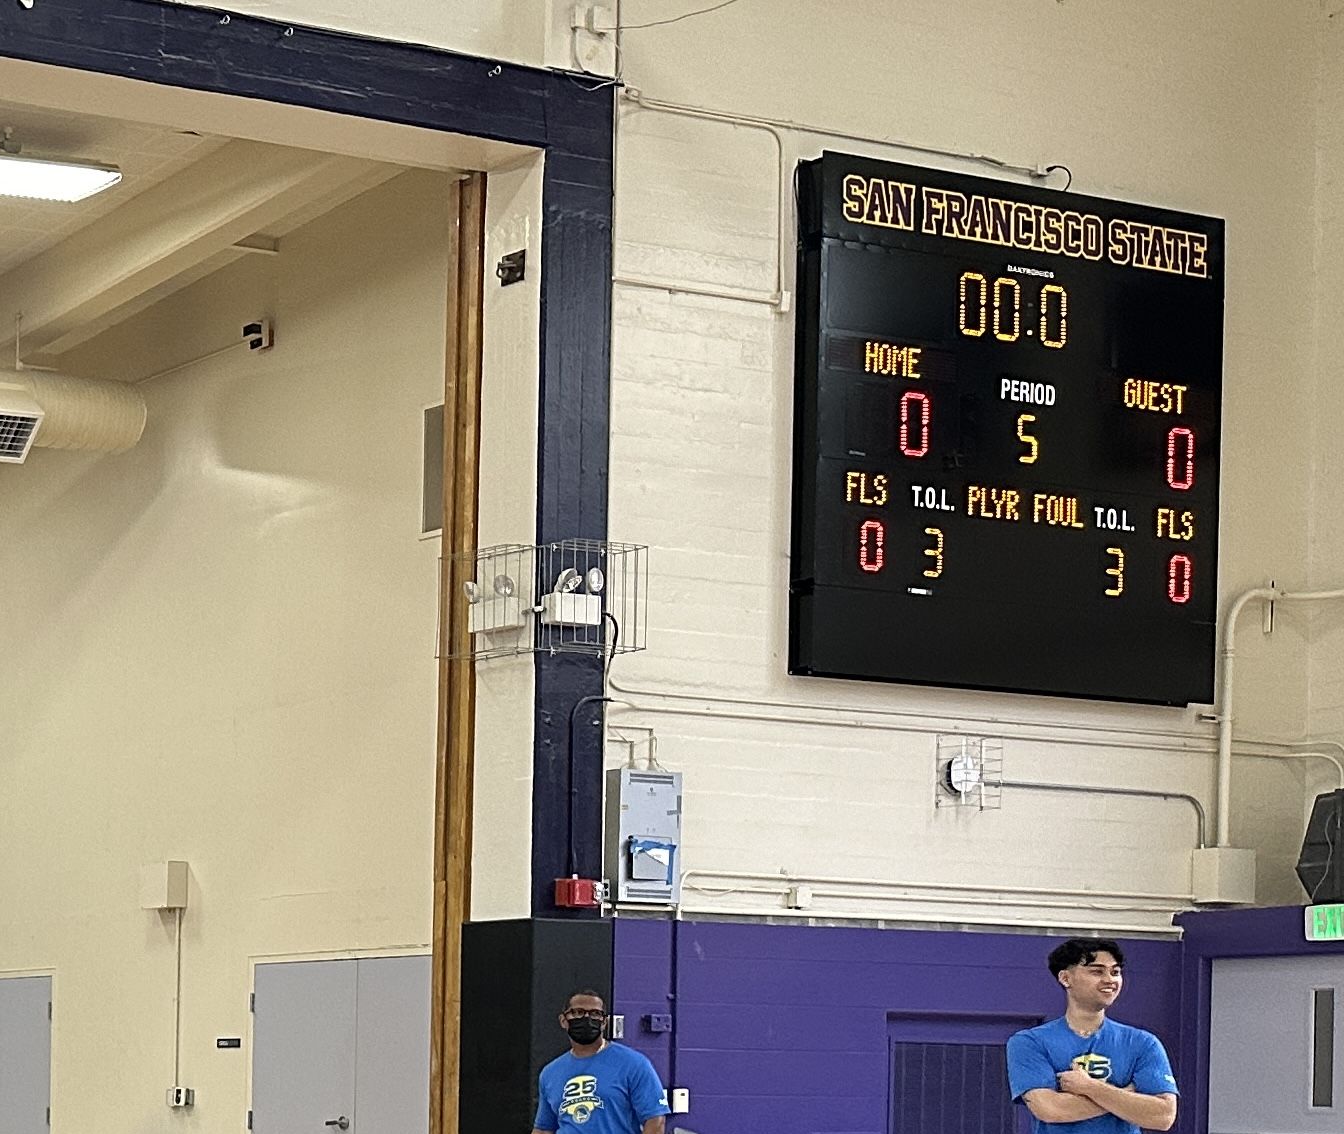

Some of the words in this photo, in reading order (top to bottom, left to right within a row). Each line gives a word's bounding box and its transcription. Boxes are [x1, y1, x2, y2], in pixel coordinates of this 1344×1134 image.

[842, 173, 916, 231] SAN
[922, 186, 1104, 262] FRANCISCO
[1108, 220, 1209, 278] STATE
[959, 271, 1068, 349] 00.0
[863, 341, 922, 379] HOME
[1000, 378, 1057, 407] PERIOD
[1123, 378, 1187, 415] GUEST
[900, 391, 930, 458] 0
[1017, 413, 1040, 464] 5
[1167, 427, 1195, 490] 0
[845, 471, 888, 506] FLS
[912, 485, 955, 512] T.O.L.
[966, 485, 1020, 522] PLYR
[1033, 493, 1084, 531] FOUL
[1094, 507, 1135, 533] T.O.L.
[1157, 509, 1194, 542] FLS
[859, 520, 885, 573] 0
[923, 527, 944, 579] 3
[1105, 547, 1125, 597] 3
[1169, 554, 1192, 604] 0
[564, 1079, 596, 1097] 25
